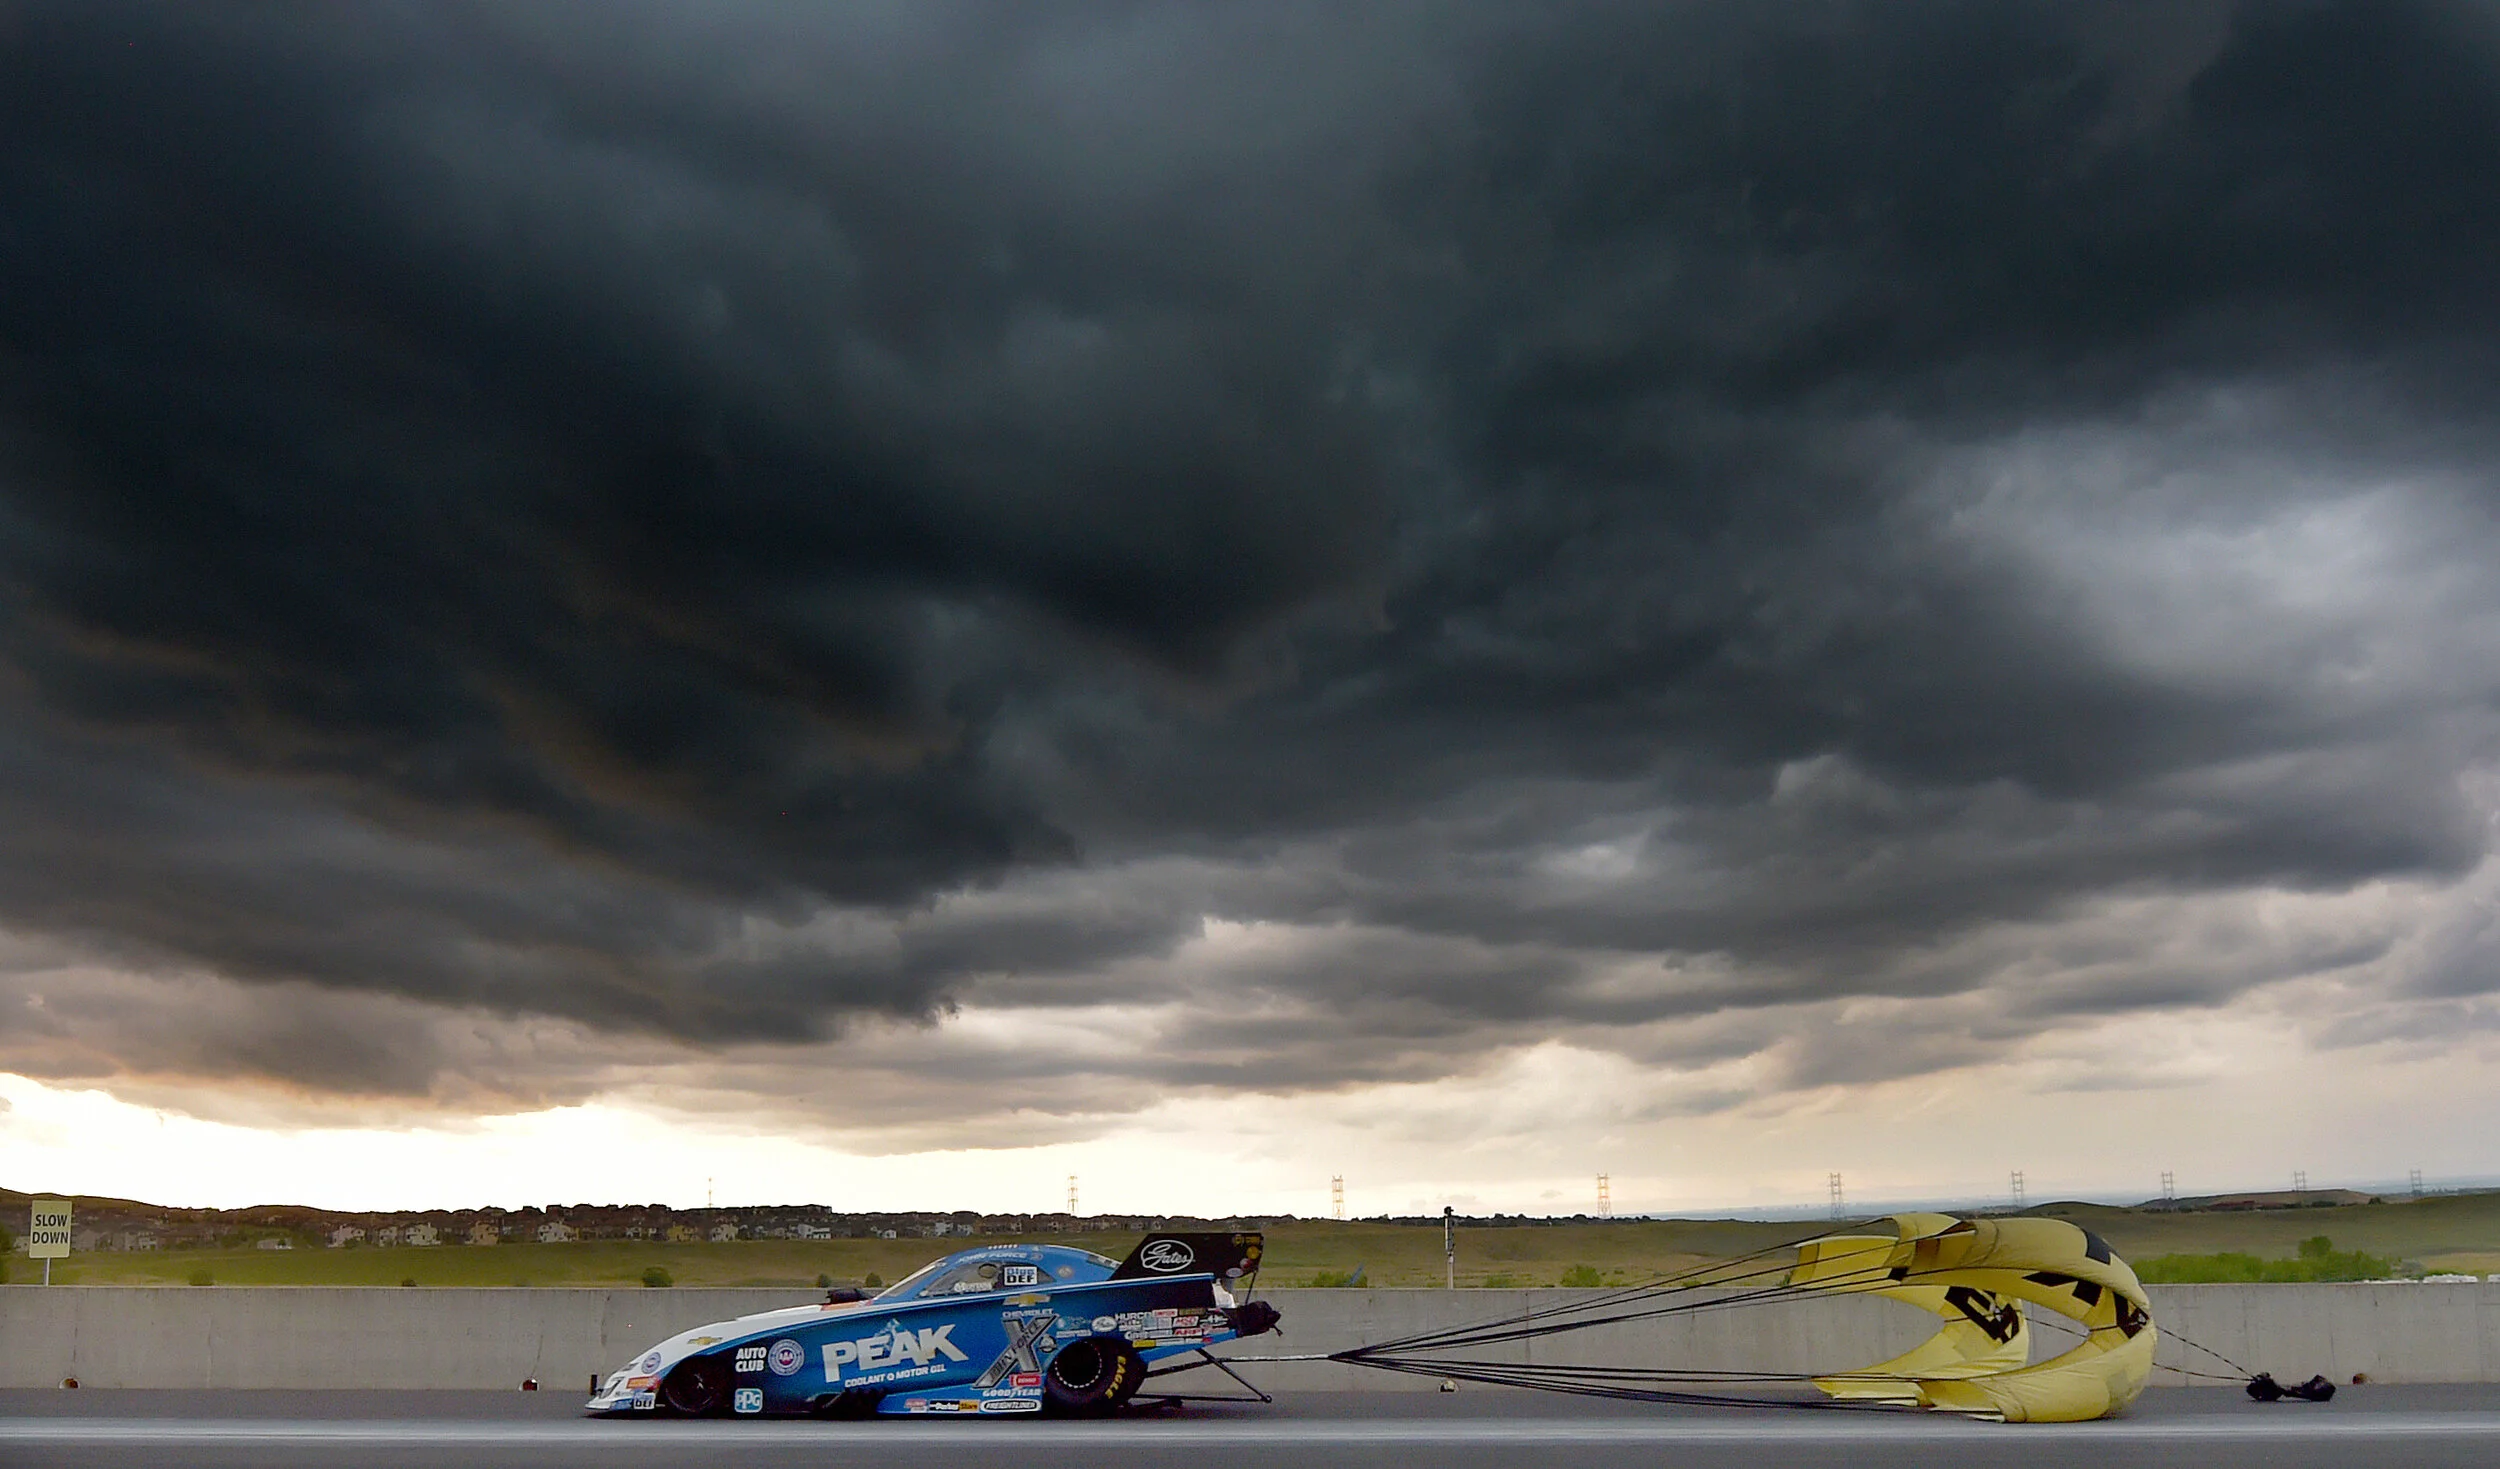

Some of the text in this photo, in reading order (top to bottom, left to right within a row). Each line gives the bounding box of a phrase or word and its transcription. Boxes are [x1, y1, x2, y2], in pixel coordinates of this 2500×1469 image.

[35, 1214, 68, 1227] SLOW
[32, 1232, 68, 1244] DOWN
[1141, 1244, 1194, 1268] Gates
[1006, 1275, 1035, 1283] DEF
[1002, 1308, 1053, 1318] CHEVROLET
[735, 1347, 767, 1360] AUTO
[821, 1323, 969, 1383] PEAK
[735, 1360, 764, 1373] CLUB
[844, 1373, 886, 1388] COOLANT
[895, 1366, 929, 1380] MOTOR
[930, 1364, 947, 1373] OIL
[1104, 1355, 1127, 1399] EAGLE
[735, 1391, 761, 1409] PPG
[982, 1389, 1041, 1398] GOODYEAR
